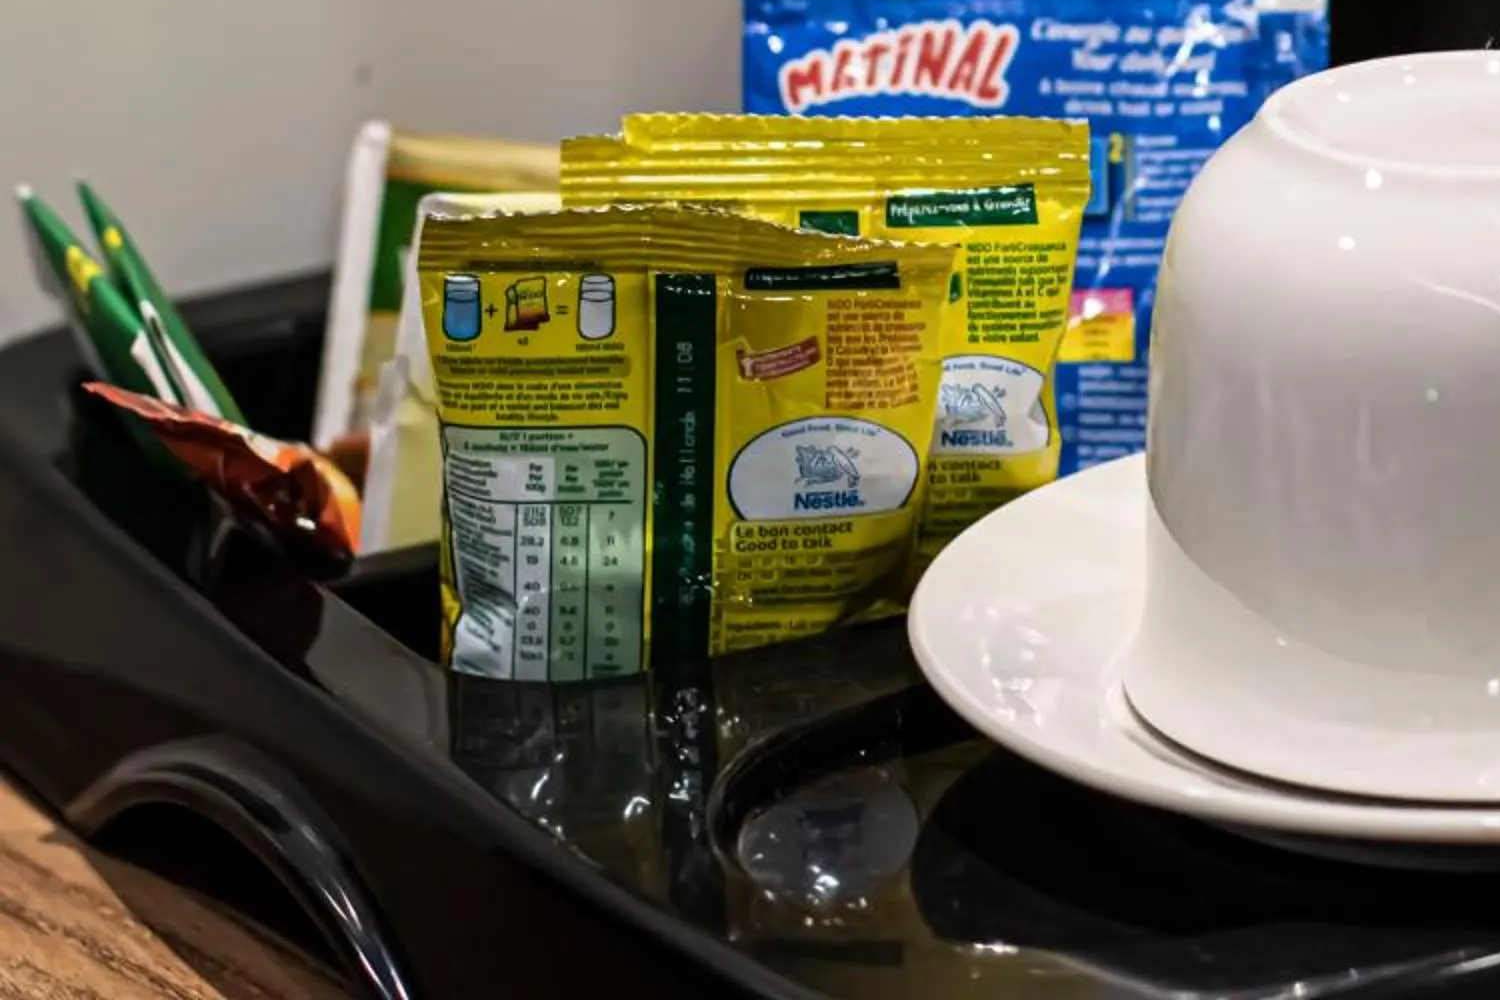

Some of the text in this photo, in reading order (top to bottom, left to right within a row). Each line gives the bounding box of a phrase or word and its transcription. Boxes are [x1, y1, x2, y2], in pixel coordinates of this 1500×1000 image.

[783, 22, 1016, 109] MATINAL
[940, 430, 1008, 447] Nestlé
[942, 459, 1001, 473] contact
[794, 491, 860, 511] Nestlé
[736, 521, 854, 538] Le bon contact
[735, 537, 833, 553] Good to talk
